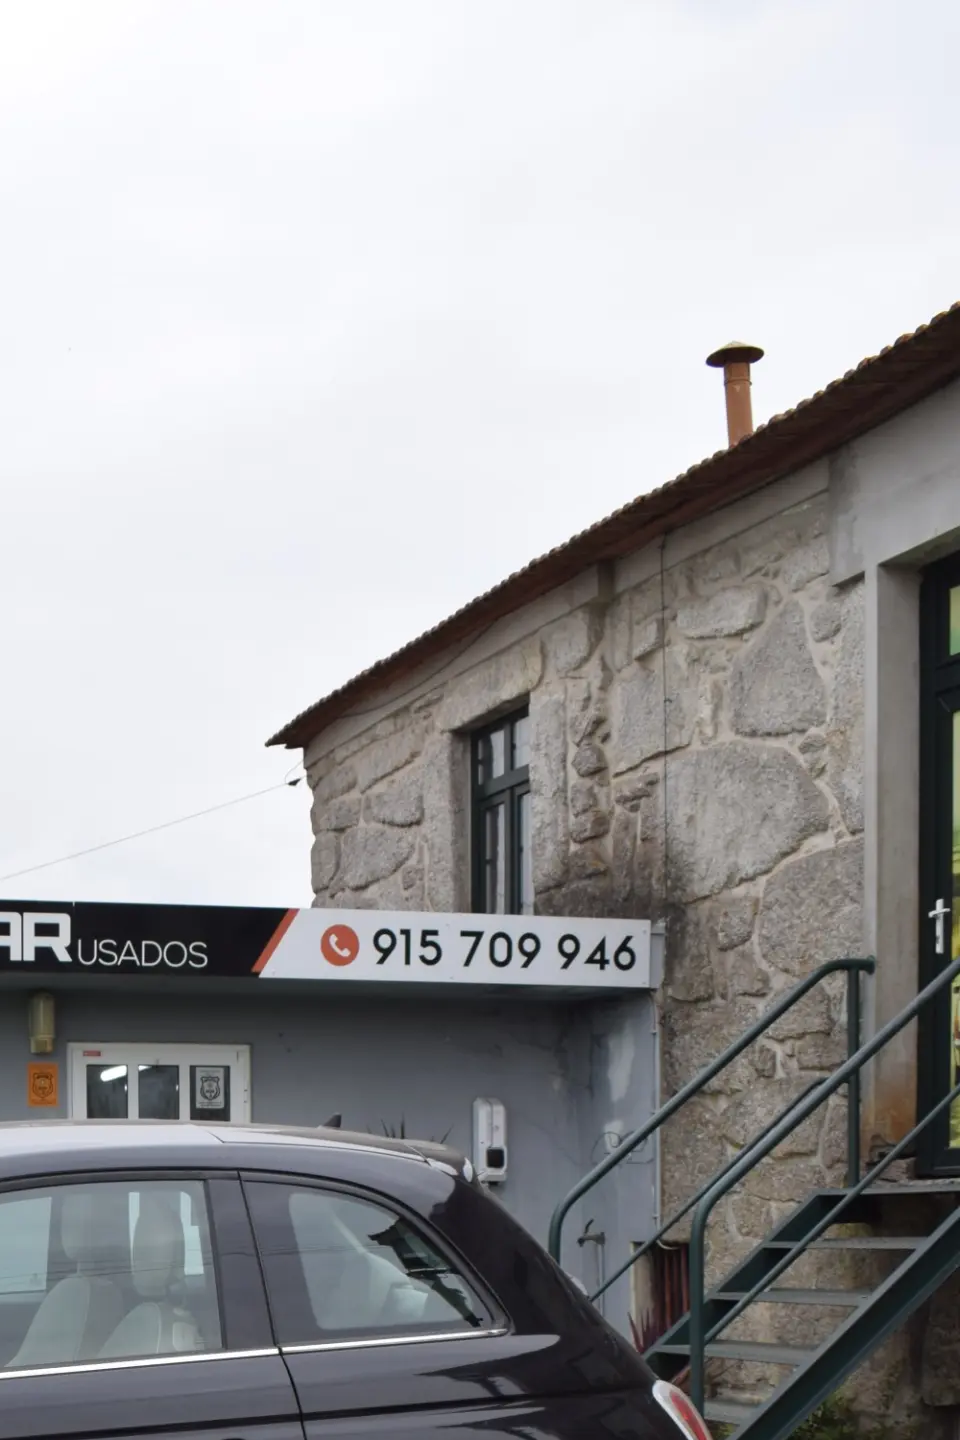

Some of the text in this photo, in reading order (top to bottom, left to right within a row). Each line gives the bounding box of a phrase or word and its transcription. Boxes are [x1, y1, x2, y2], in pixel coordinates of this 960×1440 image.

[78, 939, 208, 968] USADOS
[373, 928, 636, 971] 915 709 946
